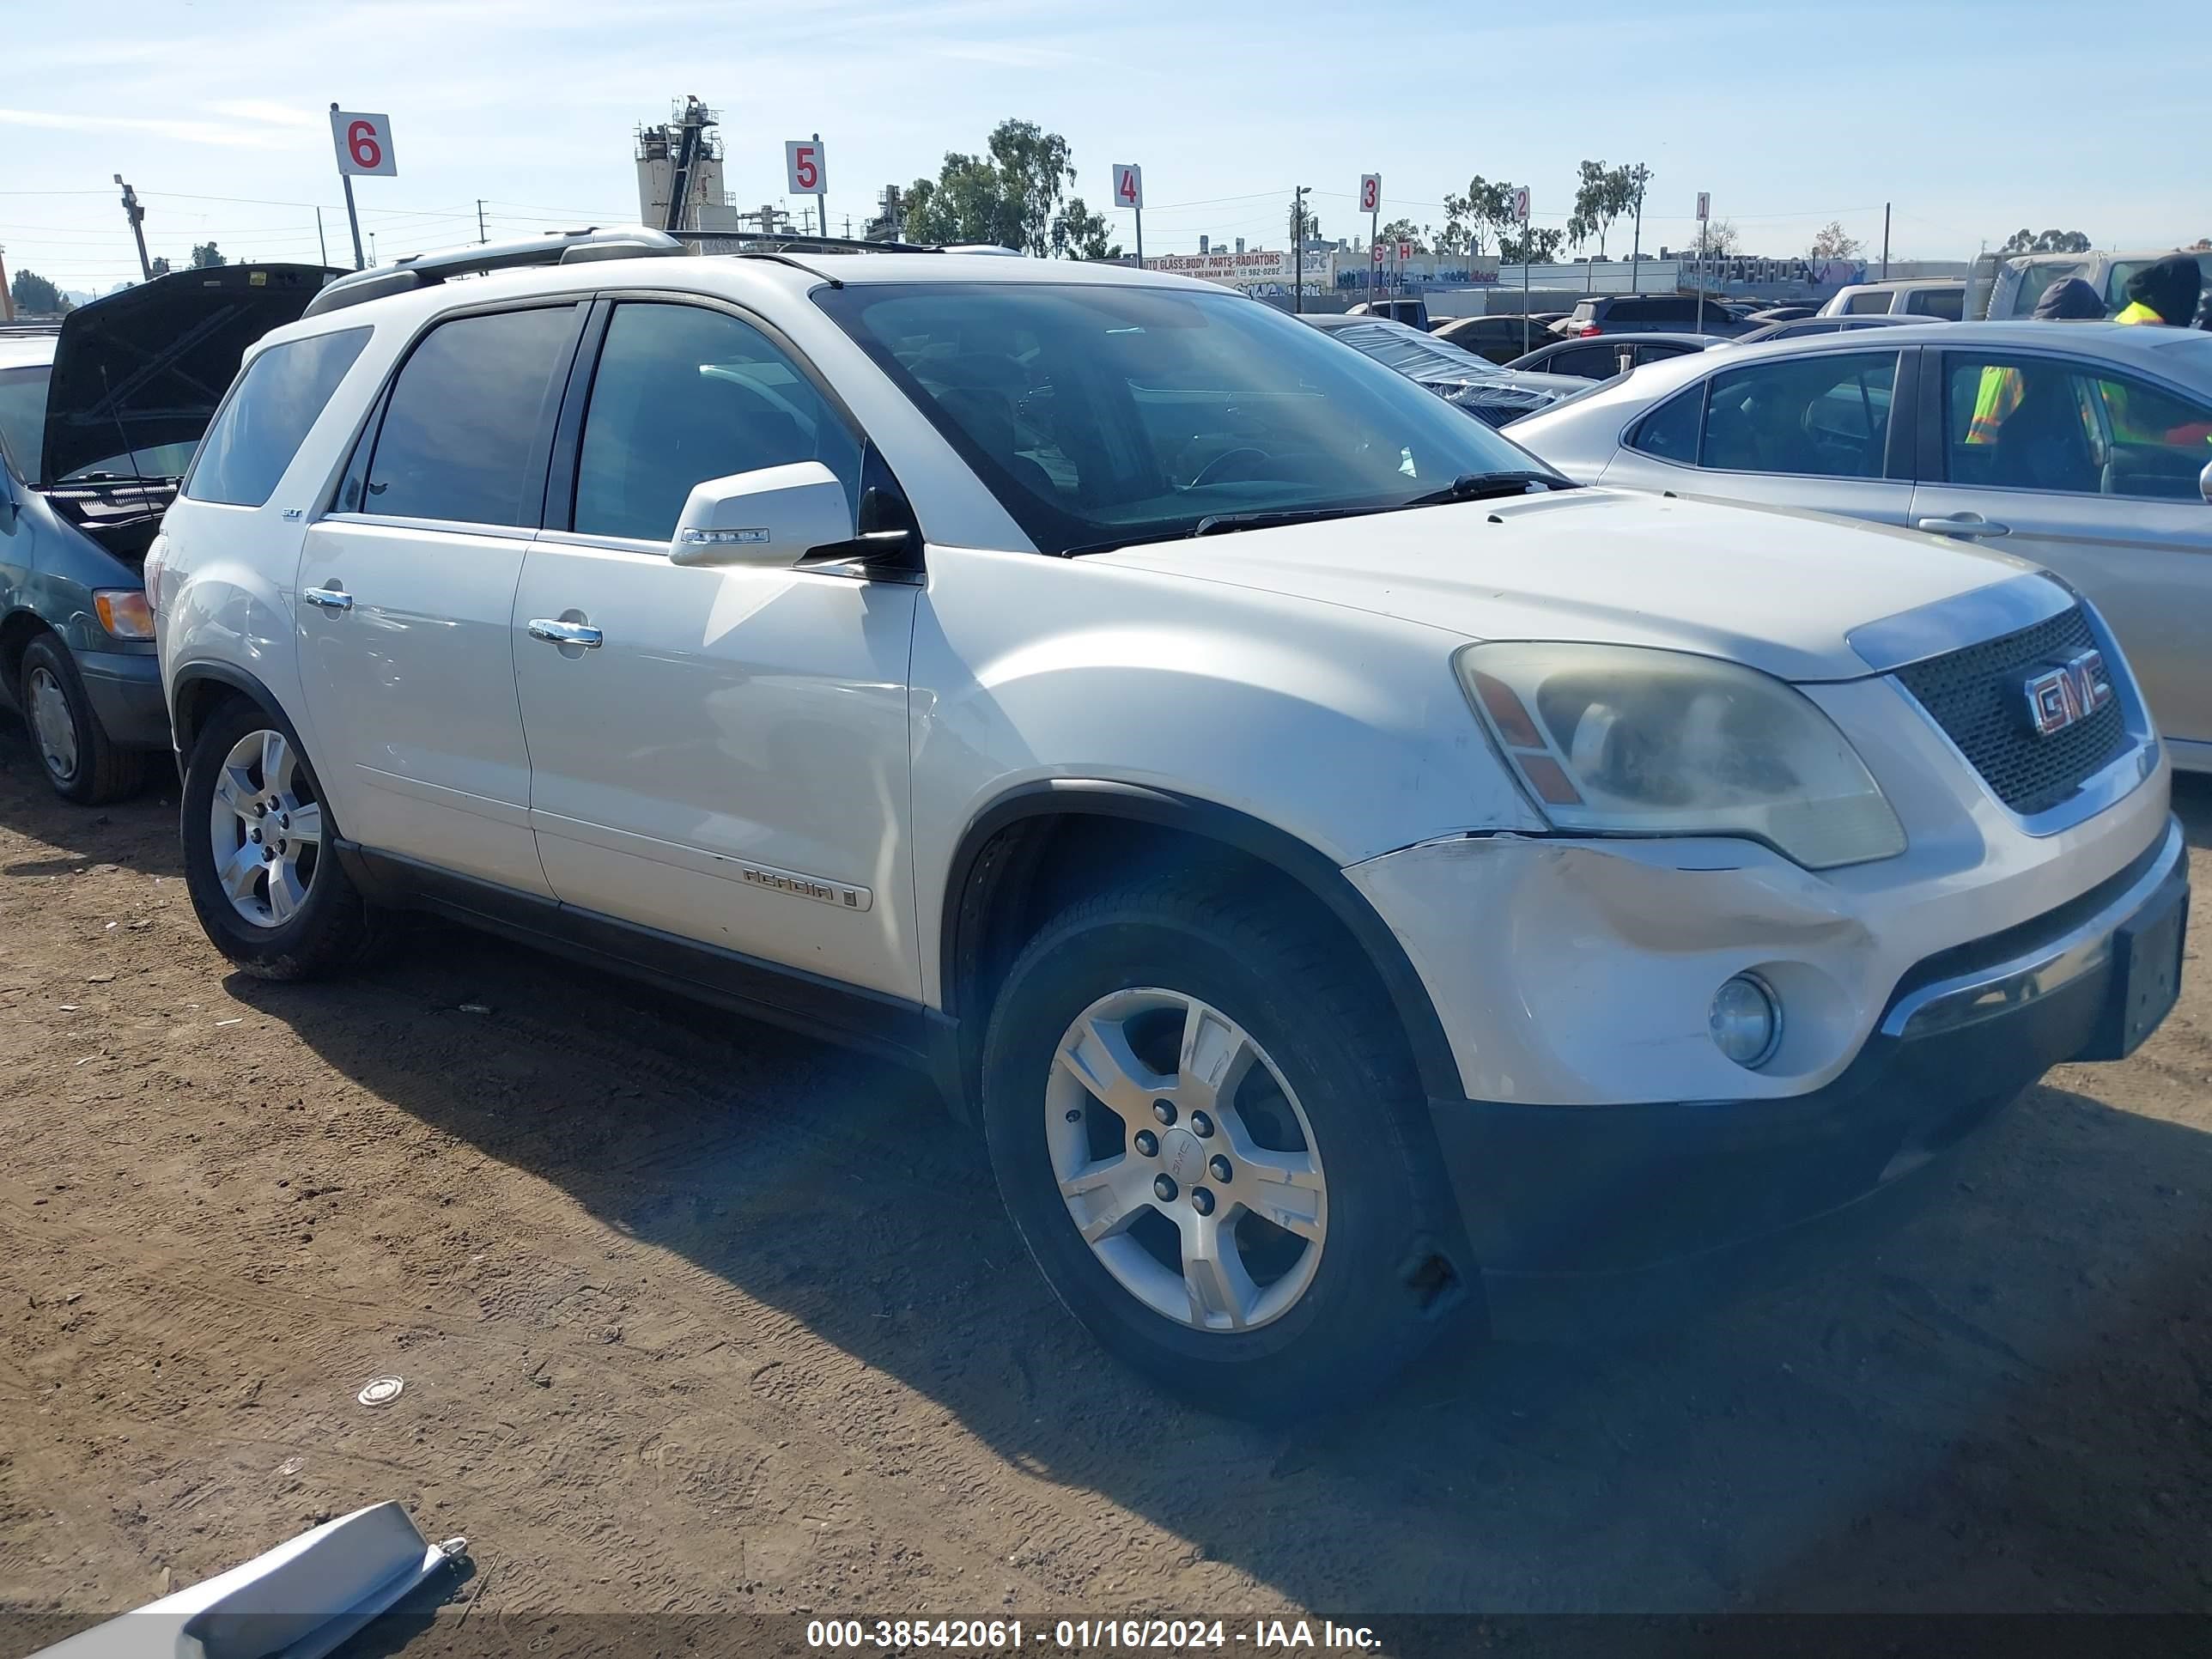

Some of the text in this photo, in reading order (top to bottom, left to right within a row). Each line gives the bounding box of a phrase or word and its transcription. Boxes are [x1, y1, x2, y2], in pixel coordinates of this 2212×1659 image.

[348, 120, 381, 168] 6
[796, 148, 817, 188] 5
[1120, 170, 1137, 204] 4
[1364, 179, 1376, 208] 3
[1517, 191, 1527, 216] 2
[1699, 196, 1707, 218] 1
[1374, 246, 1383, 262] G
[1400, 245, 1411, 259] H
[2025, 649, 2111, 736] GMC
[742, 867, 834, 900] ACADIA
[1173, 1139, 1191, 1176] GMC
